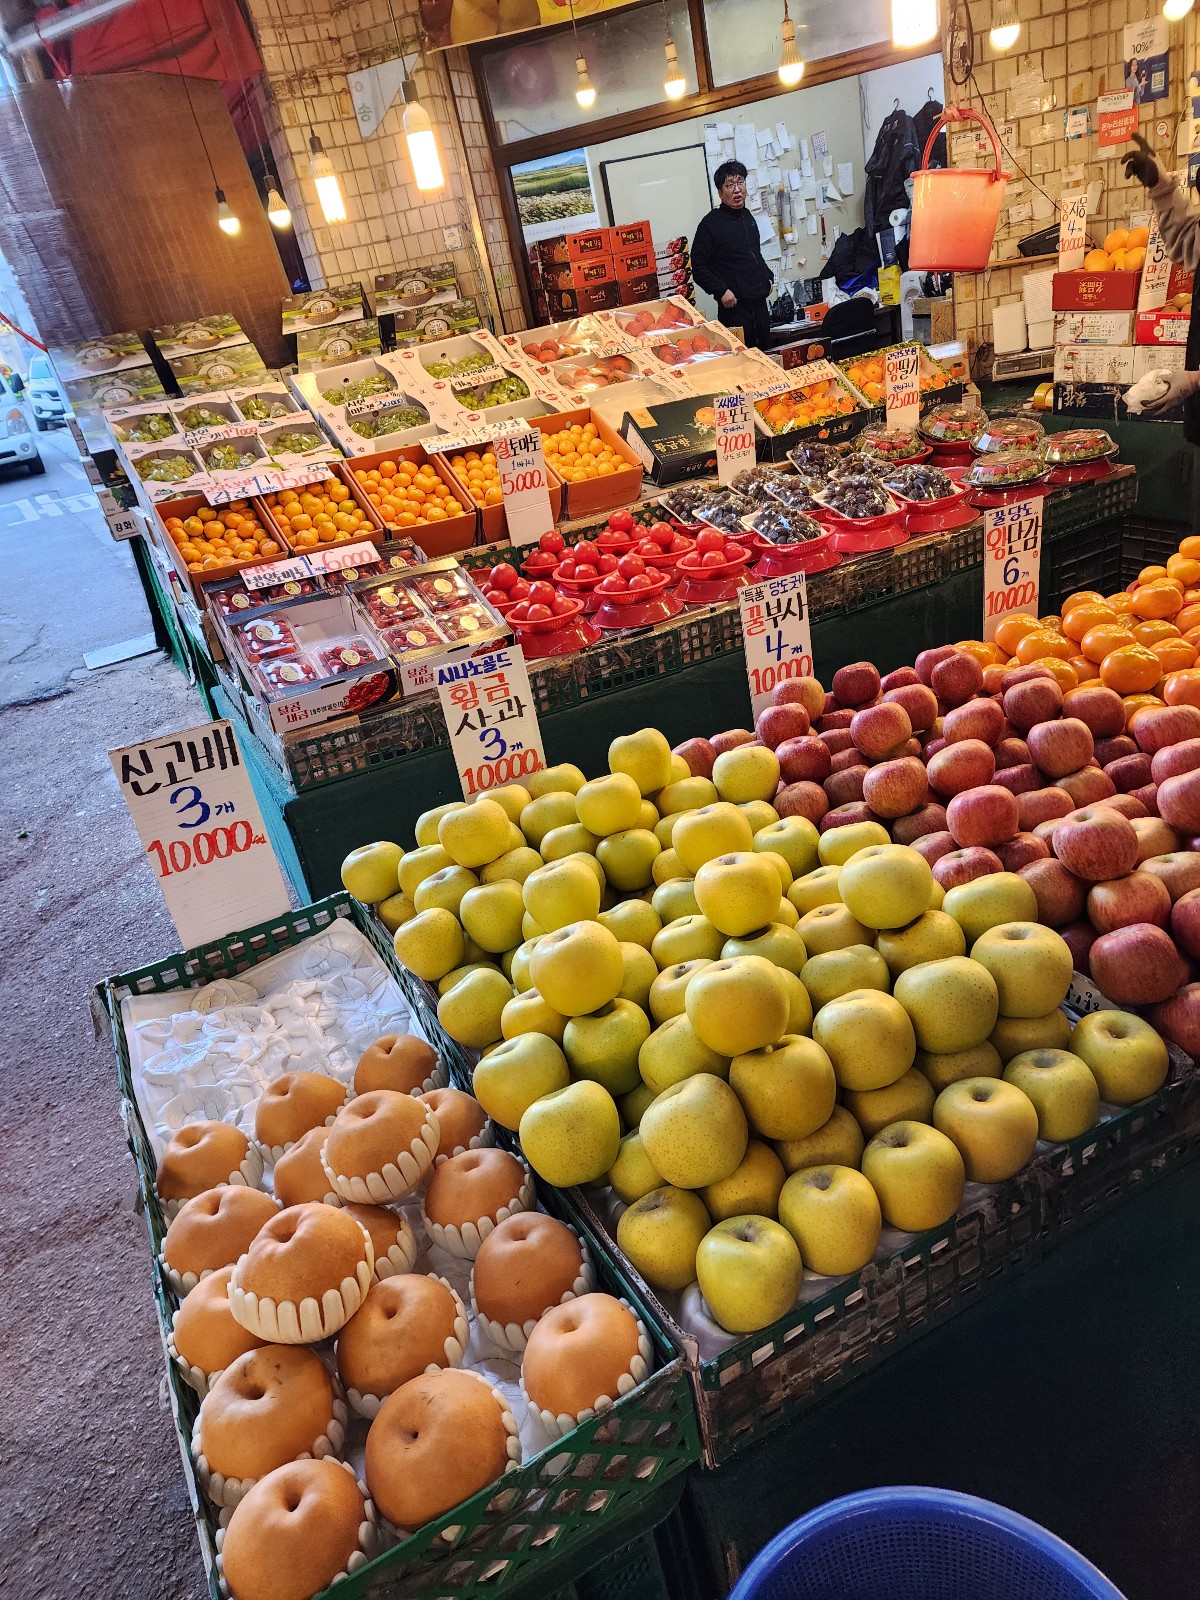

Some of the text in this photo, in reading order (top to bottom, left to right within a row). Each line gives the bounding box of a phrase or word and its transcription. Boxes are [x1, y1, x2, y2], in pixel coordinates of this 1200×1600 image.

[887, 355, 919, 382] 왕딸기
[716, 405, 751, 426] 꿀포도
[986, 515, 1042, 561] 왕단감
[744, 592, 808, 636] 꿀부사
[438, 651, 513, 685] 시나노골드
[277, 701, 301, 715] 달콤
[448, 672, 510, 711] 황금
[286, 709, 309, 724] 새콤
[454, 695, 528, 736] 사과
[121, 726, 240, 796] 신고배
